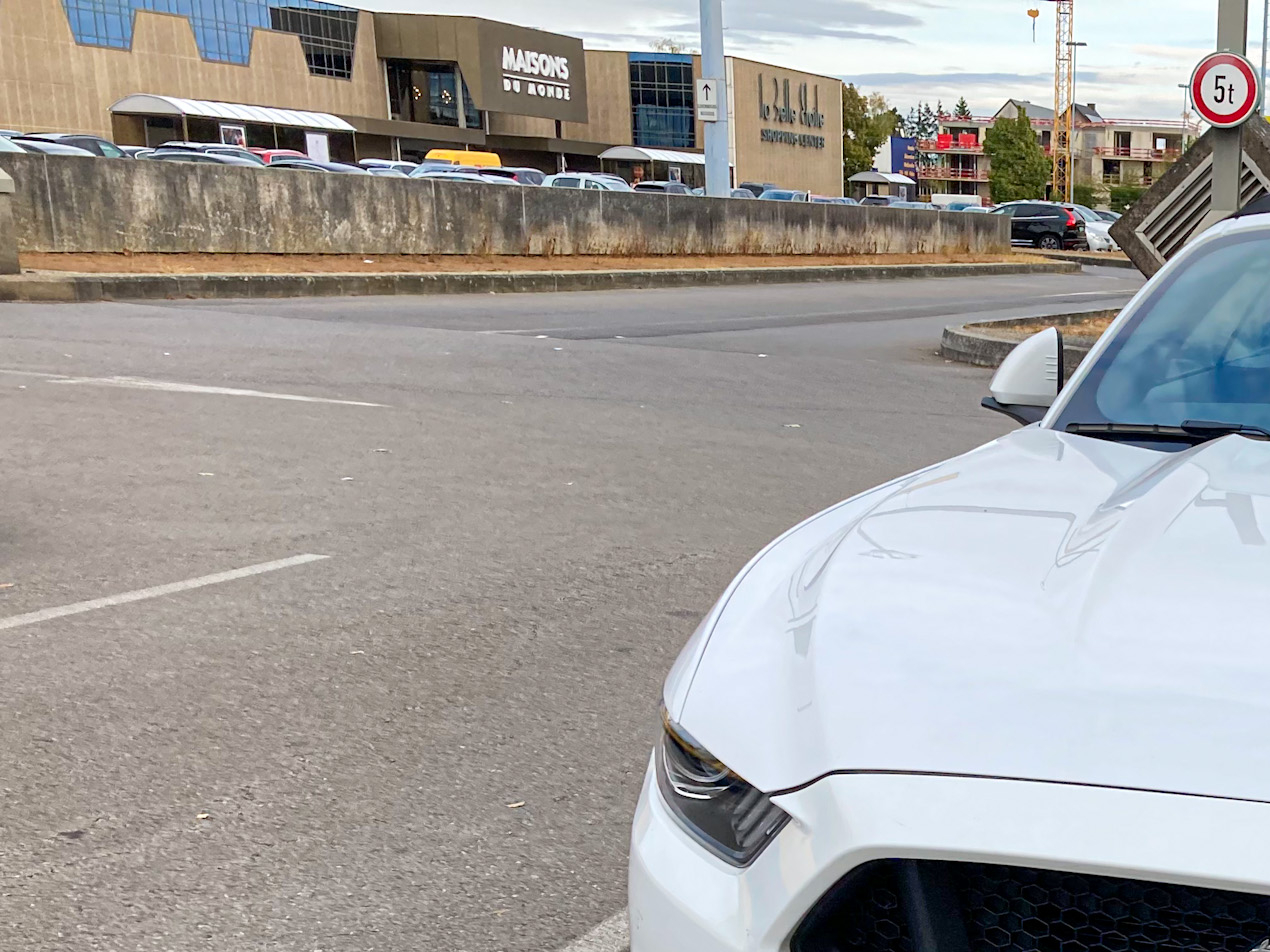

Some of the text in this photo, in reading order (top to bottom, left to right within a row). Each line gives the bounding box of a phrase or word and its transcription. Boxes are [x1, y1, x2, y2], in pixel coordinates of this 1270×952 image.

[502, 46, 569, 80] MAISONS
[503, 78, 571, 101] DU MONDE
[1213, 75, 1235, 104] 5t
[761, 128, 825, 150] SHOPPING CENTER
